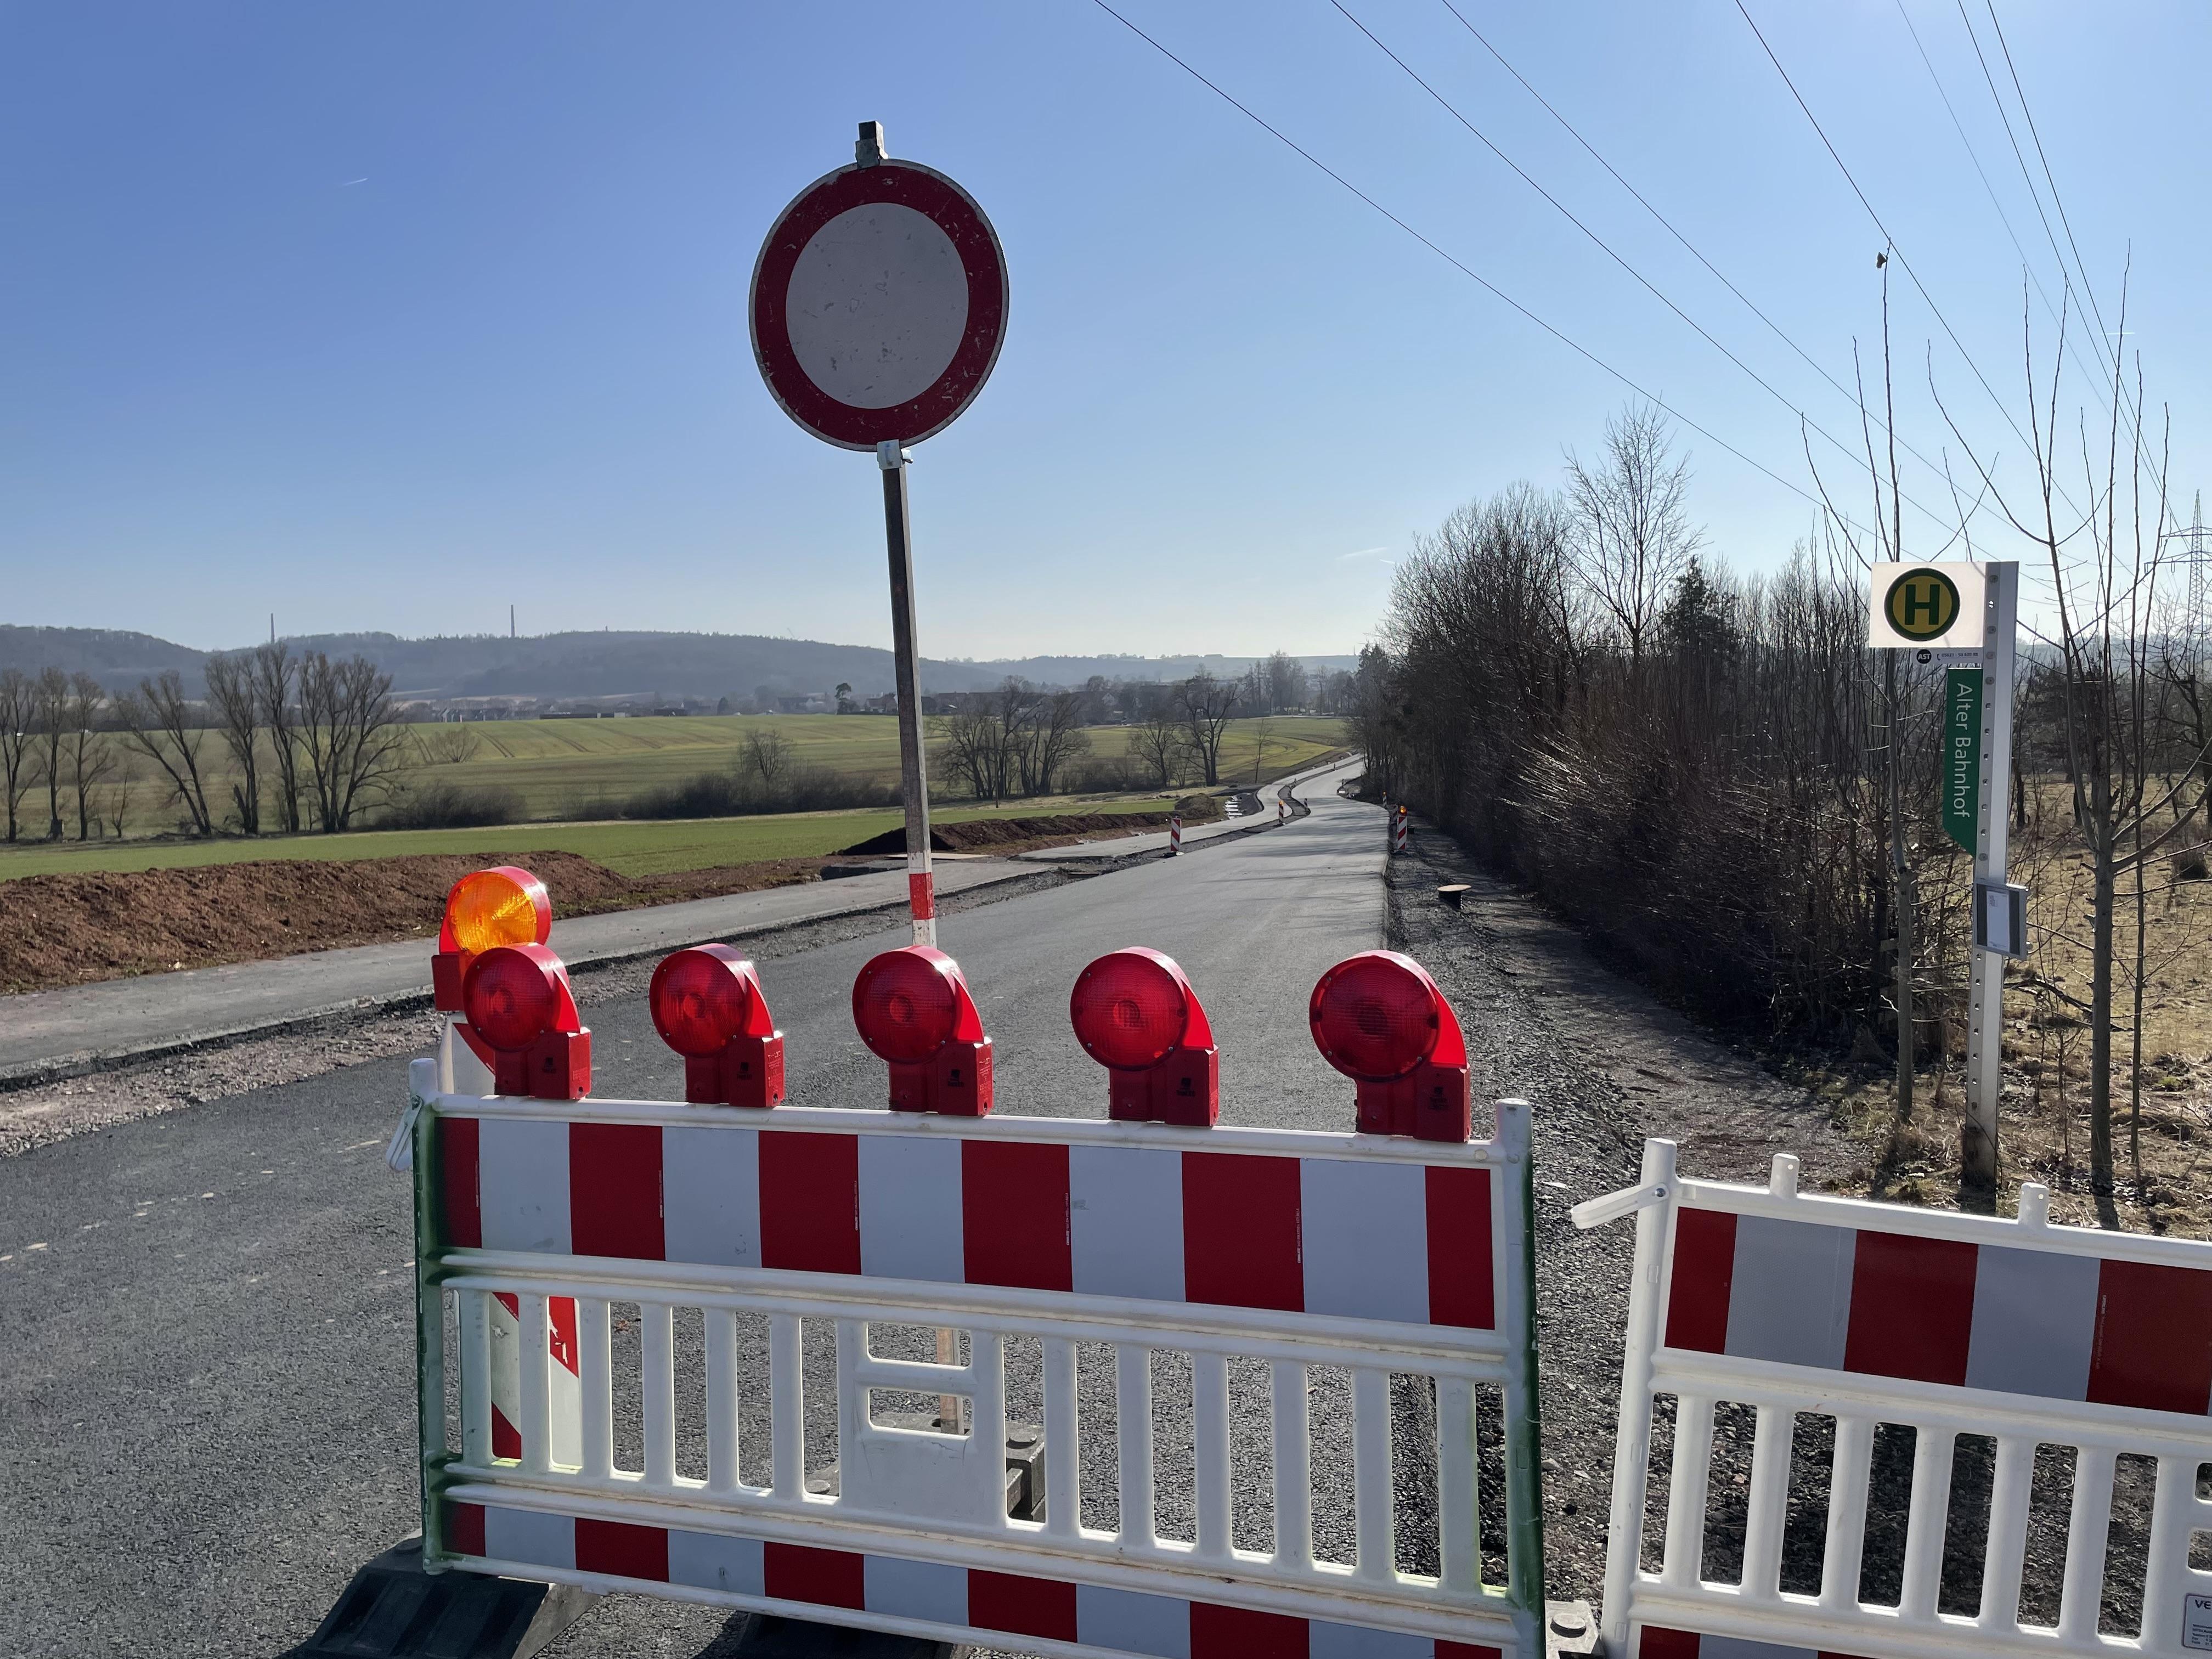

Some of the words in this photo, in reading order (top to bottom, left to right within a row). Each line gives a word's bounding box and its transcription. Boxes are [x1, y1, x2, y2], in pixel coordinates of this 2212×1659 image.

[1904, 584, 1940, 625] H
[1956, 683, 1973, 730] Alter
[1954, 737, 1971, 817] Bahnhof
